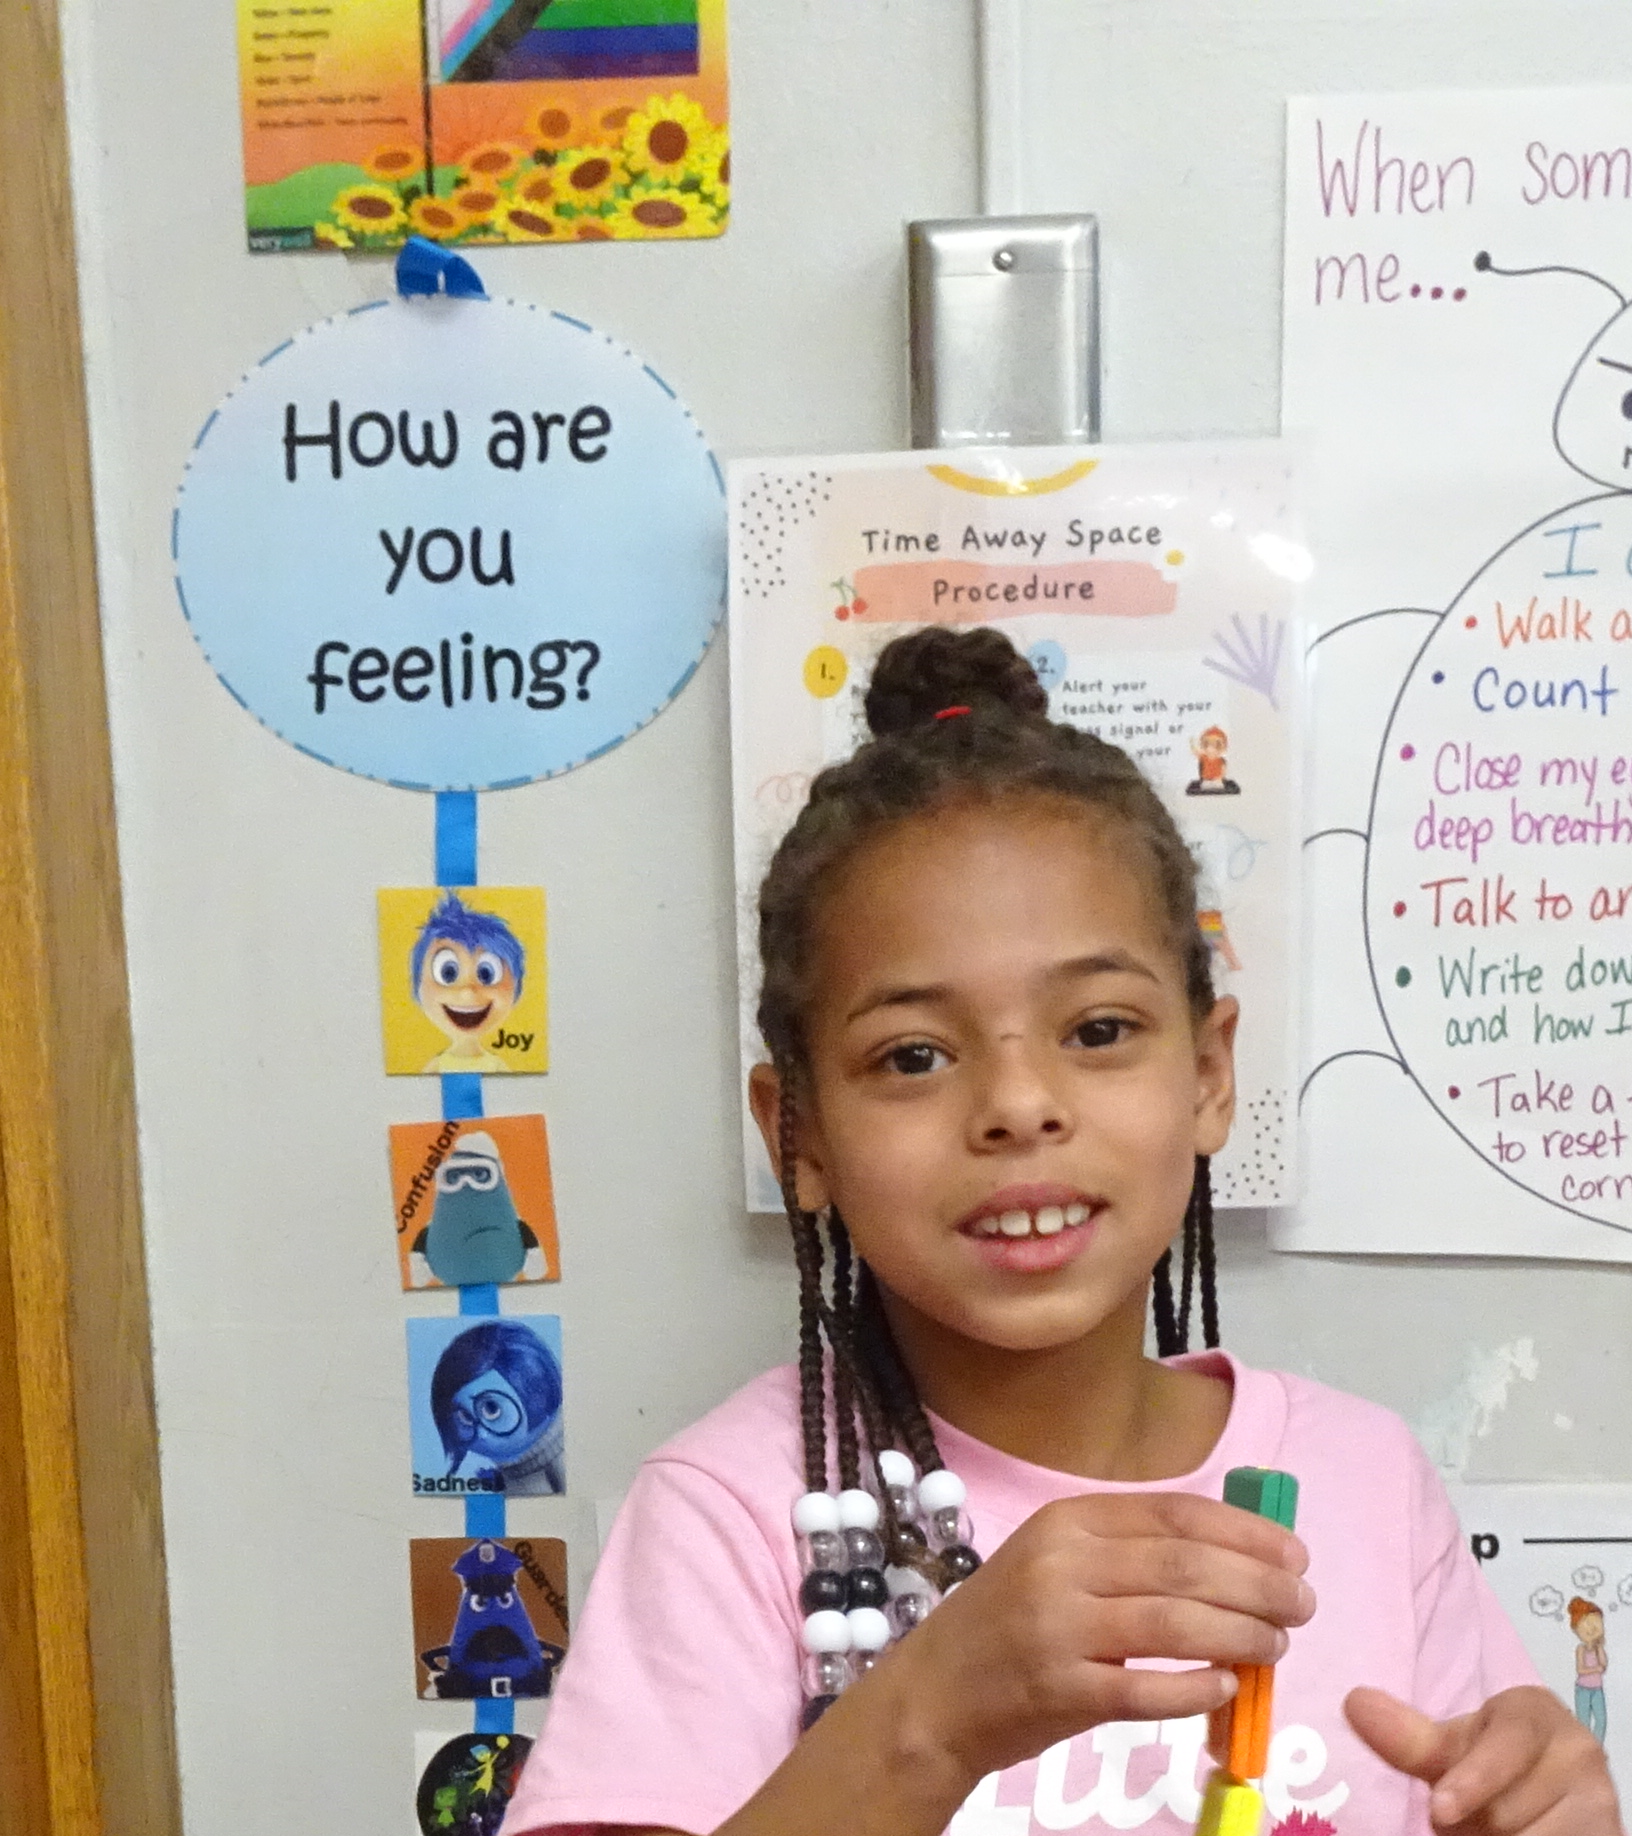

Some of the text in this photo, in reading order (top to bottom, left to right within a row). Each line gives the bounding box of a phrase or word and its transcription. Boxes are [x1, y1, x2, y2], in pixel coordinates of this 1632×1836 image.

[1316, 119, 1475, 217] When
[283, 399, 612, 483] How are
[379, 526, 515, 595] you
[861, 519, 1163, 556] Time Away Space
[1542, 522, 1603, 578] I
[933, 575, 1095, 604] Procedure
[1494, 597, 1595, 649] Walk
[307, 631, 600, 714] feeling?
[1062, 680, 1147, 695] Alert your
[1473, 665, 1620, 716] Count
[1062, 701, 1212, 716] teacher with your
[1110, 723, 1159, 739] signal
[1169, 724, 1184, 734] or
[1136, 747, 1171, 759] your
[1434, 741, 1523, 797] Close
[1540, 752, 1599, 807] my
[1414, 800, 1495, 865] deep
[1420, 874, 1518, 928] Talk
[1534, 884, 1573, 925] to
[1438, 946, 1545, 999] Write
[491, 1029, 534, 1052] Joy
[1444, 1001, 1509, 1047] and
[1533, 1002, 1596, 1045] how
[1477, 1068, 1575, 1119] Take
[1591, 1085, 1615, 1115] a
[1491, 1131, 1527, 1164] to
[1542, 1118, 1629, 1161] reset
